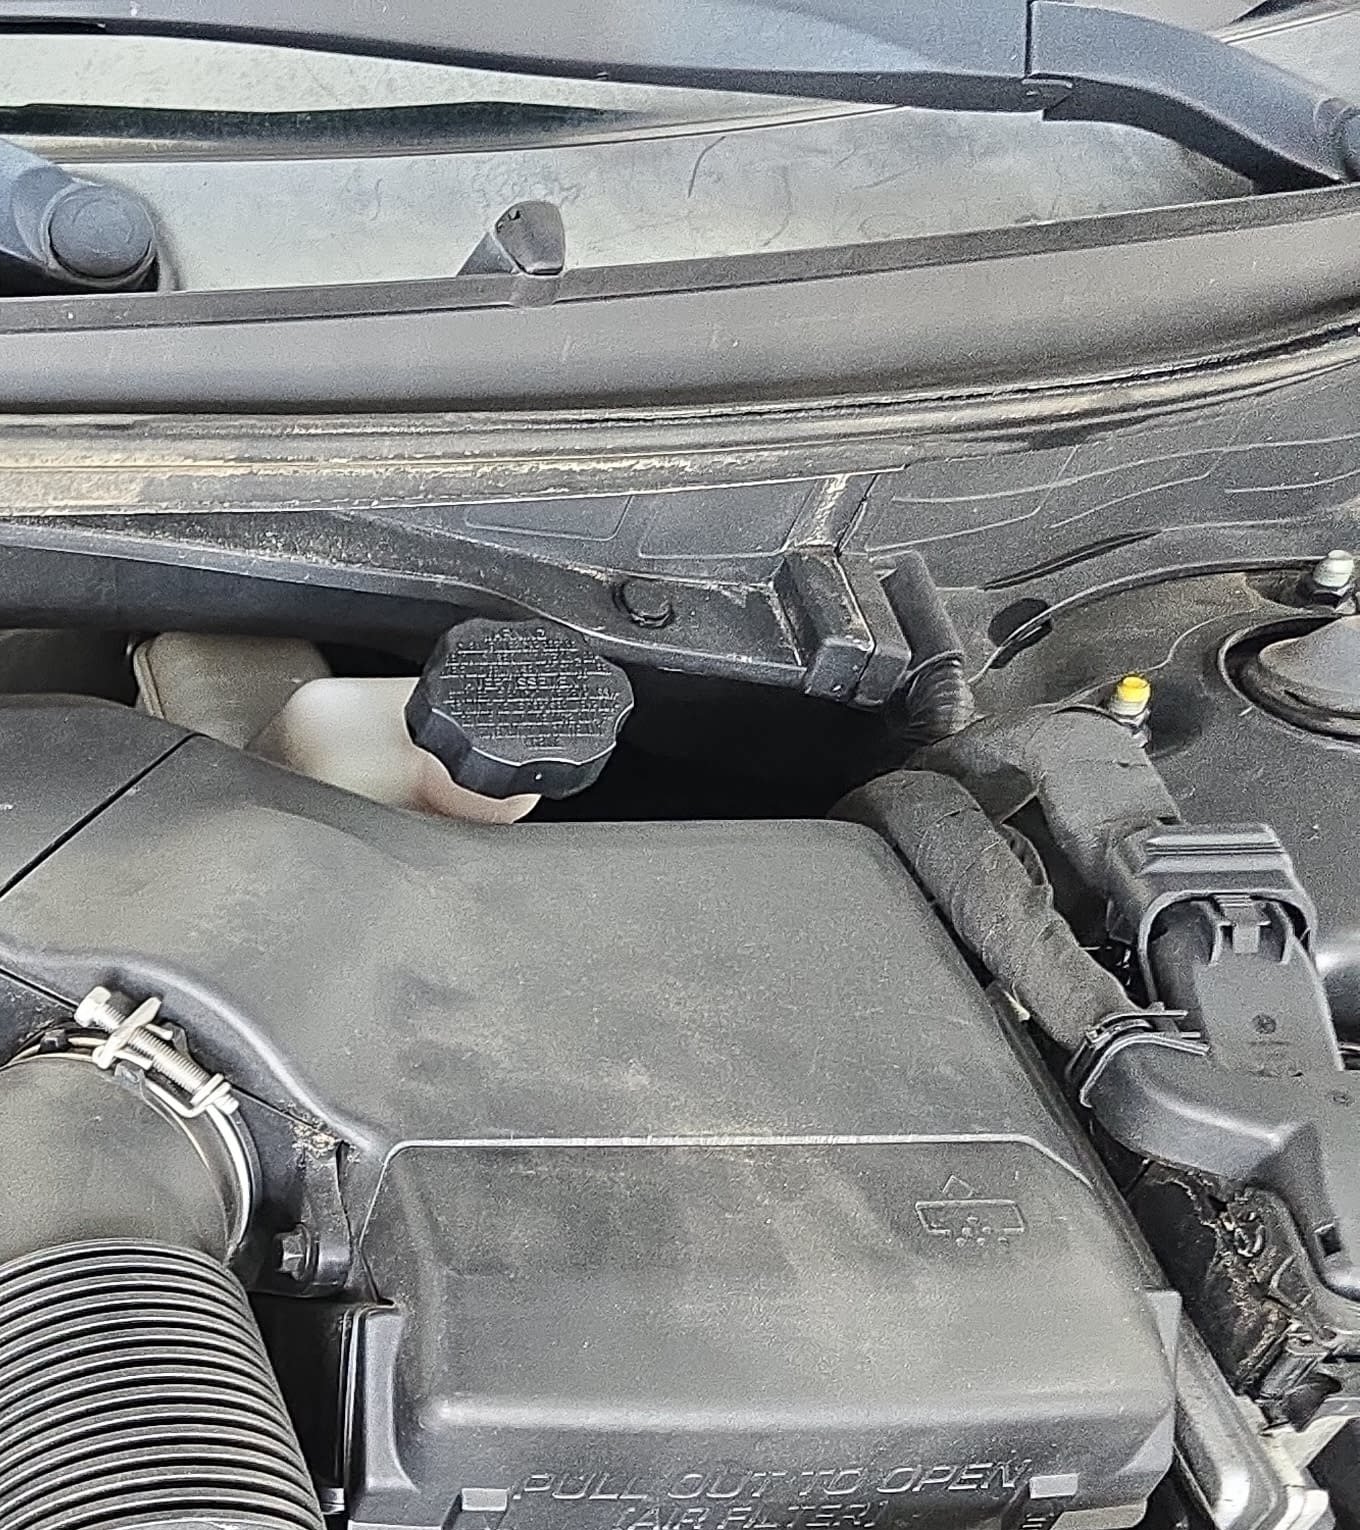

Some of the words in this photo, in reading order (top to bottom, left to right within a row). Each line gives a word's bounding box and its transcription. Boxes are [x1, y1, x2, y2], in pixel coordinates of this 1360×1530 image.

[512, 1471, 650, 1500] PULL
[667, 1470, 787, 1499] OUT
[798, 1467, 864, 1496] TO
[876, 1458, 1033, 1494] OPEN
